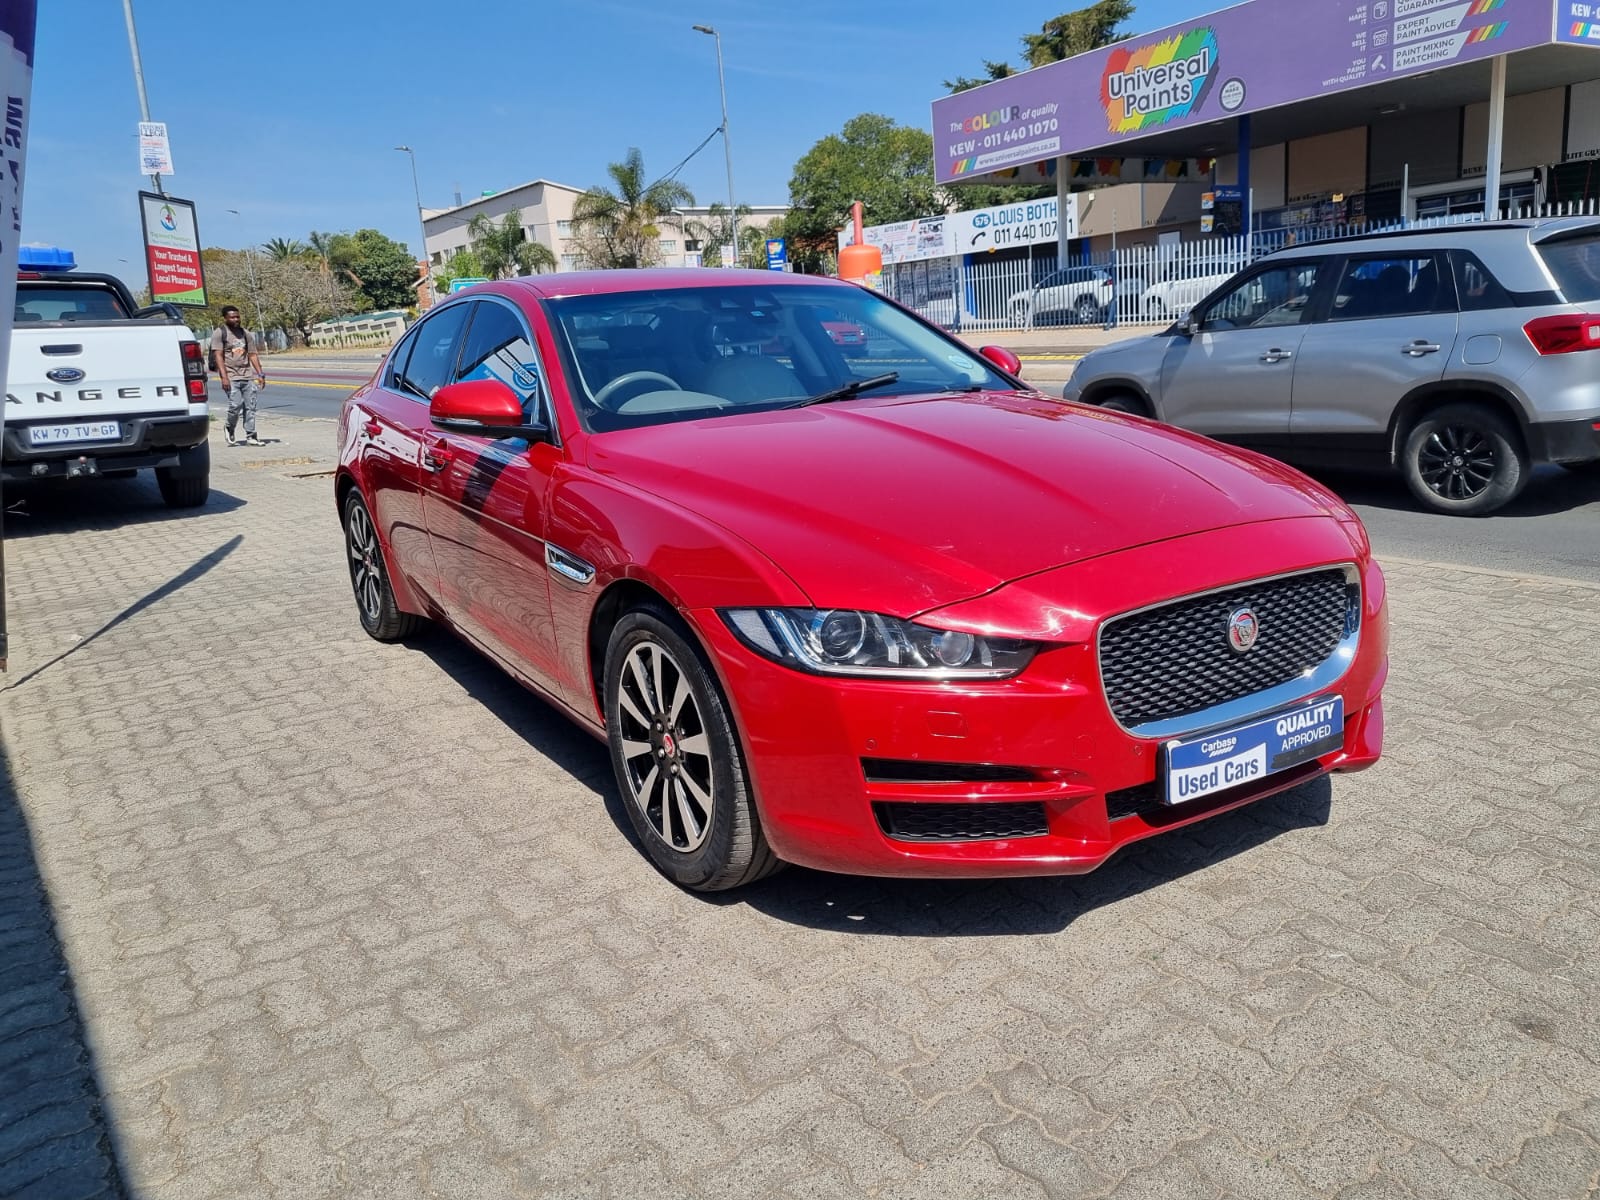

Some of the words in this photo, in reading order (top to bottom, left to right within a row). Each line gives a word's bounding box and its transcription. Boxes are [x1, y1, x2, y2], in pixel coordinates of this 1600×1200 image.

[1571, 2, 1591, 17] KEW
[1396, 29, 1422, 40] PAINT
[1423, 19, 1457, 34] ADVICE
[1397, 17, 1430, 32] EXPERT
[1396, 47, 1422, 59] PAINT
[1422, 38, 1455, 52] MIXING
[1402, 49, 1449, 66] MATCHING
[1109, 49, 1208, 98] Universal
[1339, 71, 1366, 83] QUALITY
[1125, 83, 1191, 117] Paints
[950, 122, 963, 133] The
[963, 105, 1020, 134] COLOUR
[1021, 108, 1031, 120] of
[1031, 103, 1059, 119] quality
[950, 139, 975, 157] KEW
[984, 132, 1001, 148] 011
[1003, 126, 1026, 143] 440
[1028, 118, 1058, 137] 1070
[975, 217, 989, 226] 575
[992, 207, 1024, 227] LOUIS
[1026, 201, 1058, 221] BOTH
[994, 228, 1010, 244] 011
[1014, 224, 1036, 241] 440
[154, 250, 167, 259] Your
[168, 252, 187, 262] Trusted
[154, 262, 176, 273] Longest
[176, 264, 197, 277] Serving
[156, 274, 171, 283] Local
[171, 275, 197, 288] Pharmacy
[6, 386, 179, 404] ANGER
[33, 429, 48, 441] KW
[54, 428, 70, 439] 79
[75, 426, 90, 437] TV
[101, 424, 115, 436] GP
[1276, 703, 1335, 736] QUALITY
[1201, 736, 1237, 753] Carbase
[1281, 724, 1331, 752] APPROVED
[1178, 766, 1218, 797] Used
[1224, 758, 1259, 783] Cars
